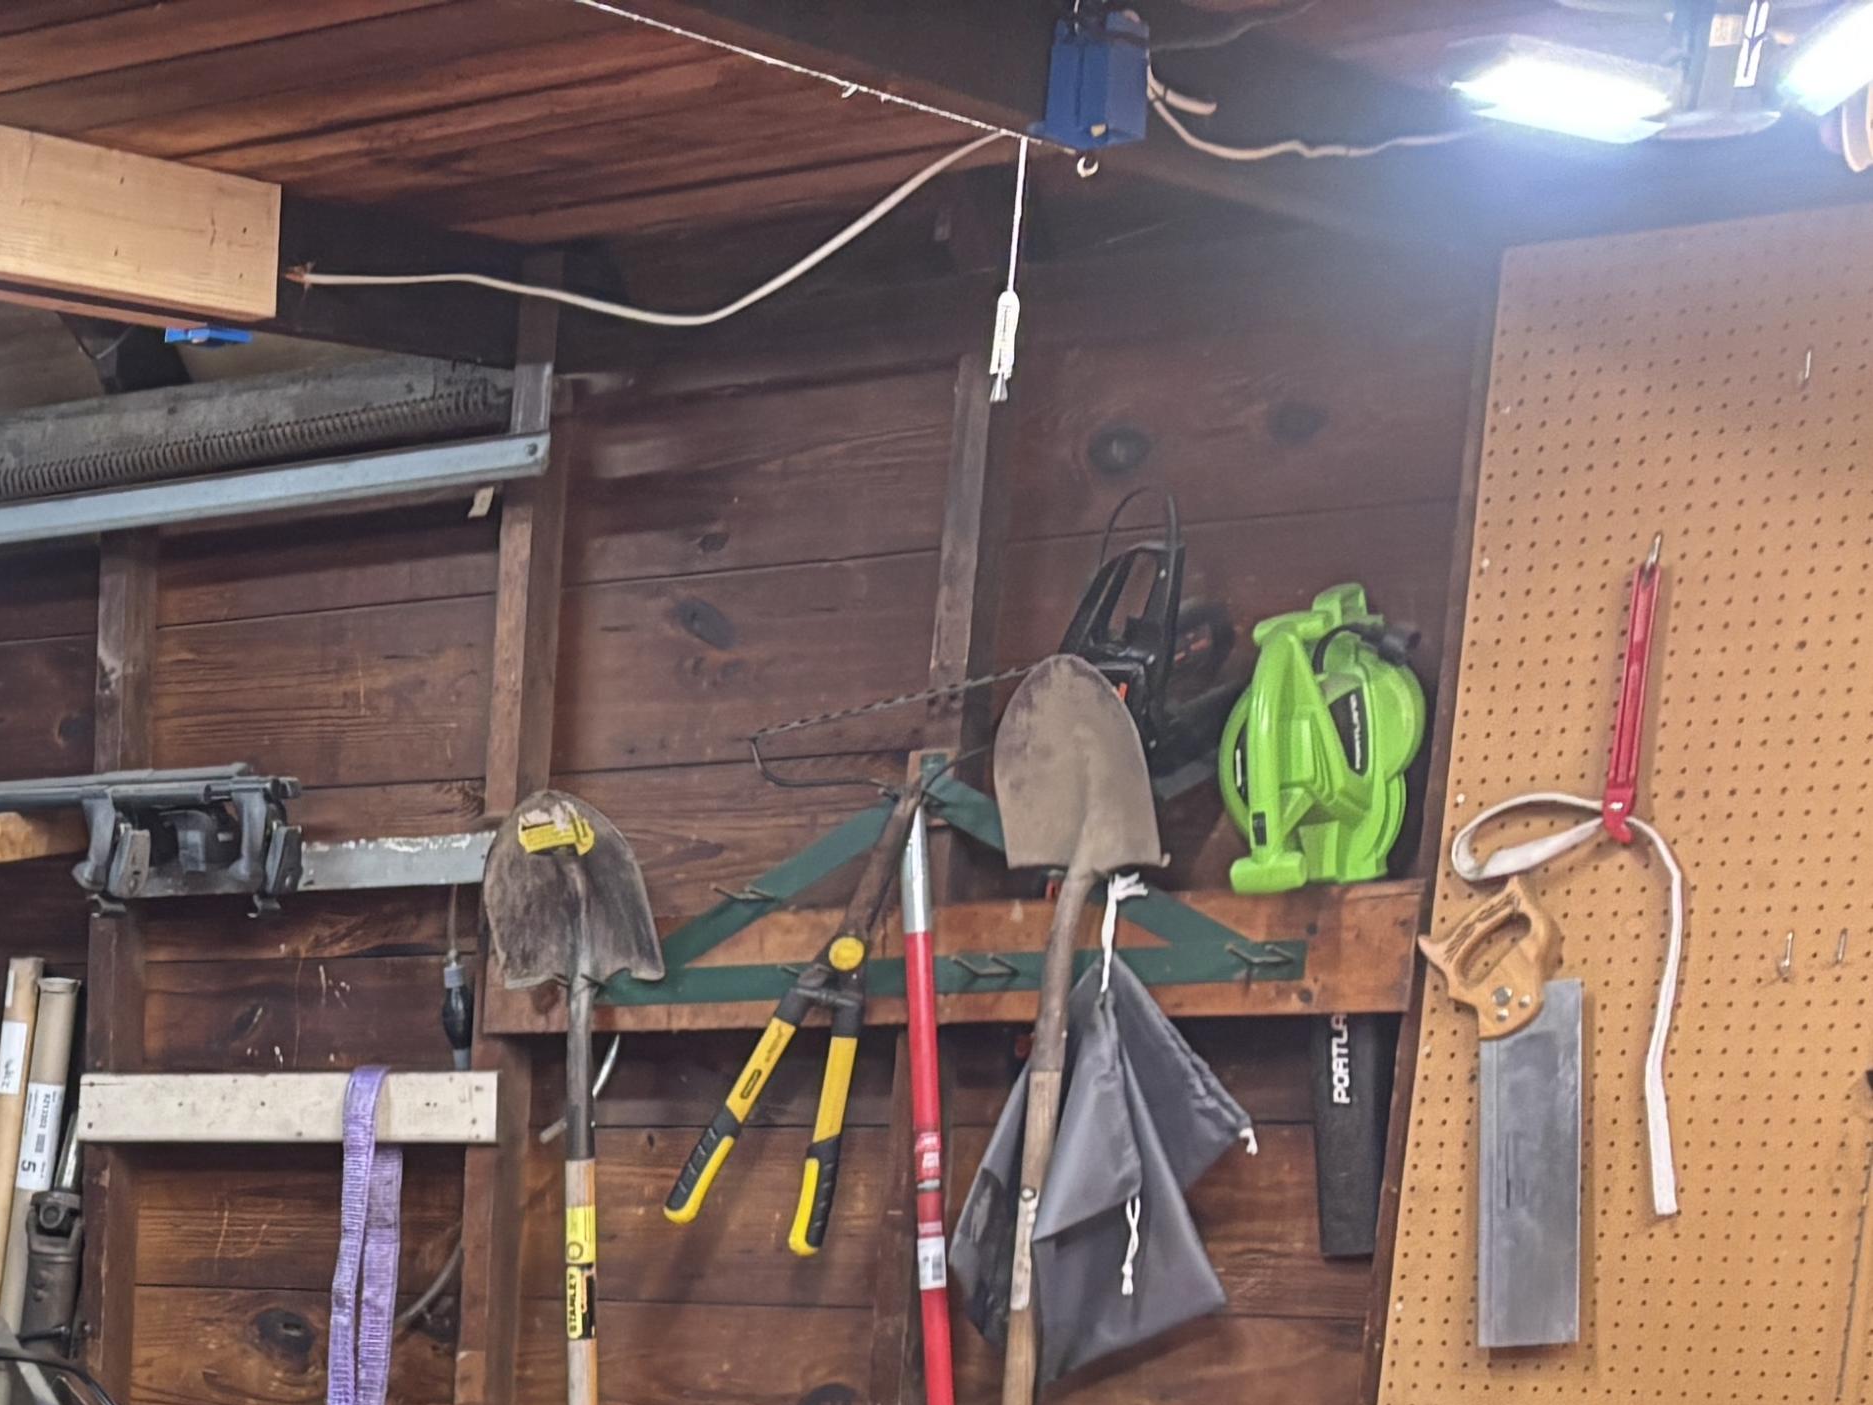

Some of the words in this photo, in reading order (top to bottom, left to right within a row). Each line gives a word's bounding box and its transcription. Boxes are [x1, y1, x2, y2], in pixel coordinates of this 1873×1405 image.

[1330, 1014, 1351, 1104] PORTLA
[21, 1160, 36, 1173] 5
[568, 1273, 577, 1333] STANLEY
